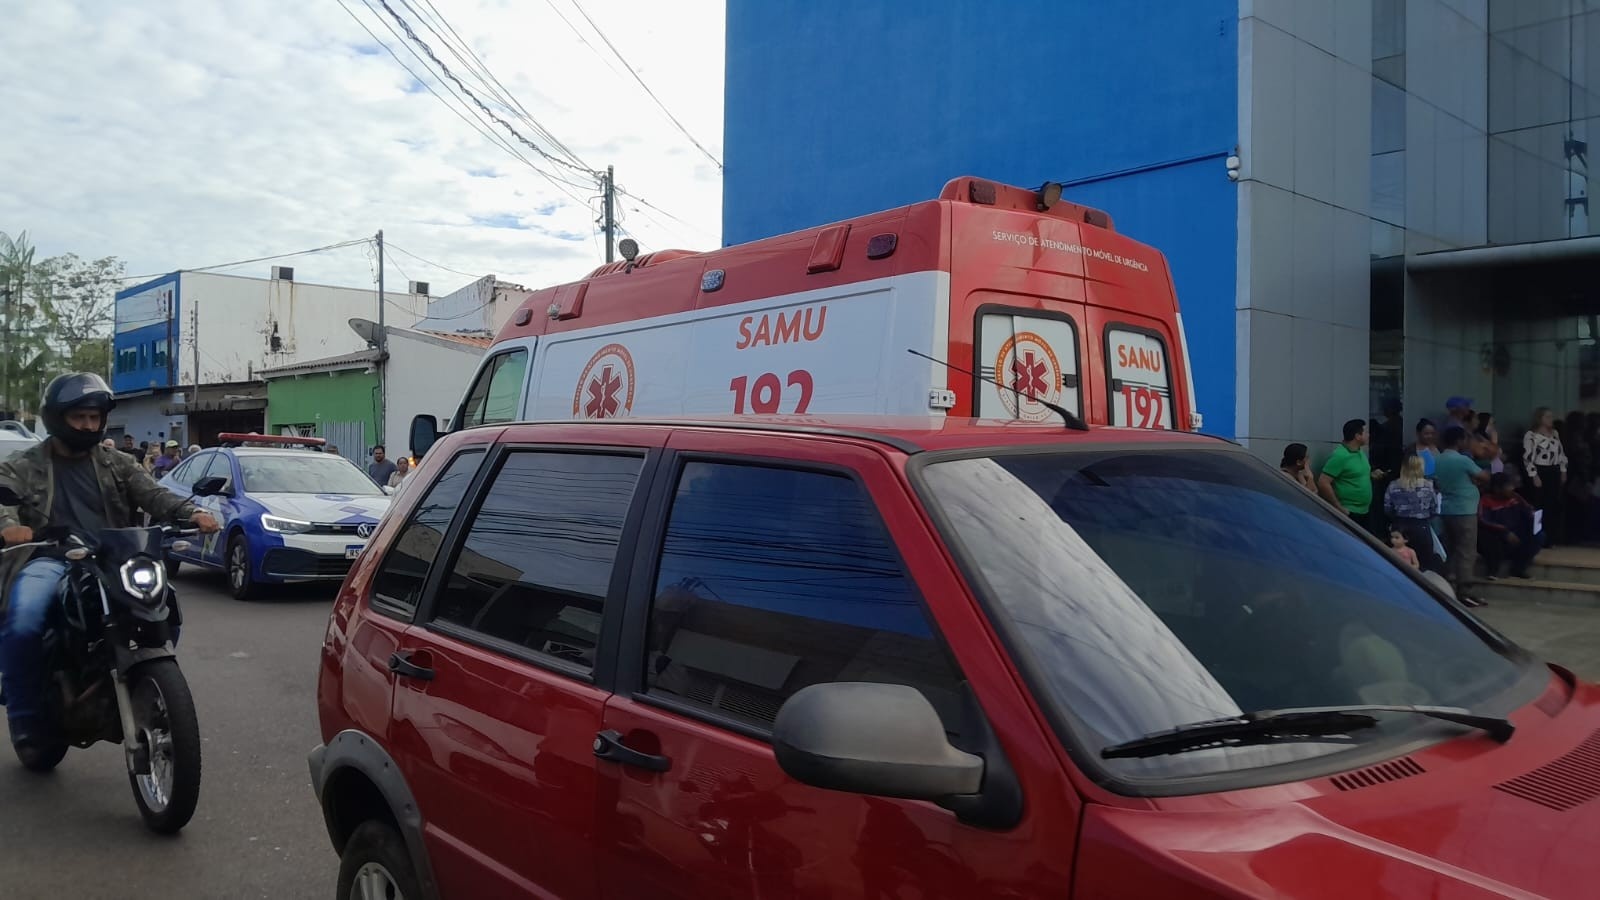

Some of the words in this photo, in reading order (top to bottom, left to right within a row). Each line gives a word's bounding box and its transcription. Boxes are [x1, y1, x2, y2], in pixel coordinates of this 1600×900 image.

[992, 230, 1027, 245] SERVIÇO
[1028, 236, 1039, 247] DE
[1040, 238, 1092, 257] ATENDIMENTO
[1093, 249, 1114, 263] MÓVEL
[1114, 255, 1122, 265] DE
[1122, 257, 1148, 271] URGÊNCIA
[736, 305, 827, 349] SAMU
[729, 369, 814, 414] 192
[1122, 385, 1165, 429] 192
